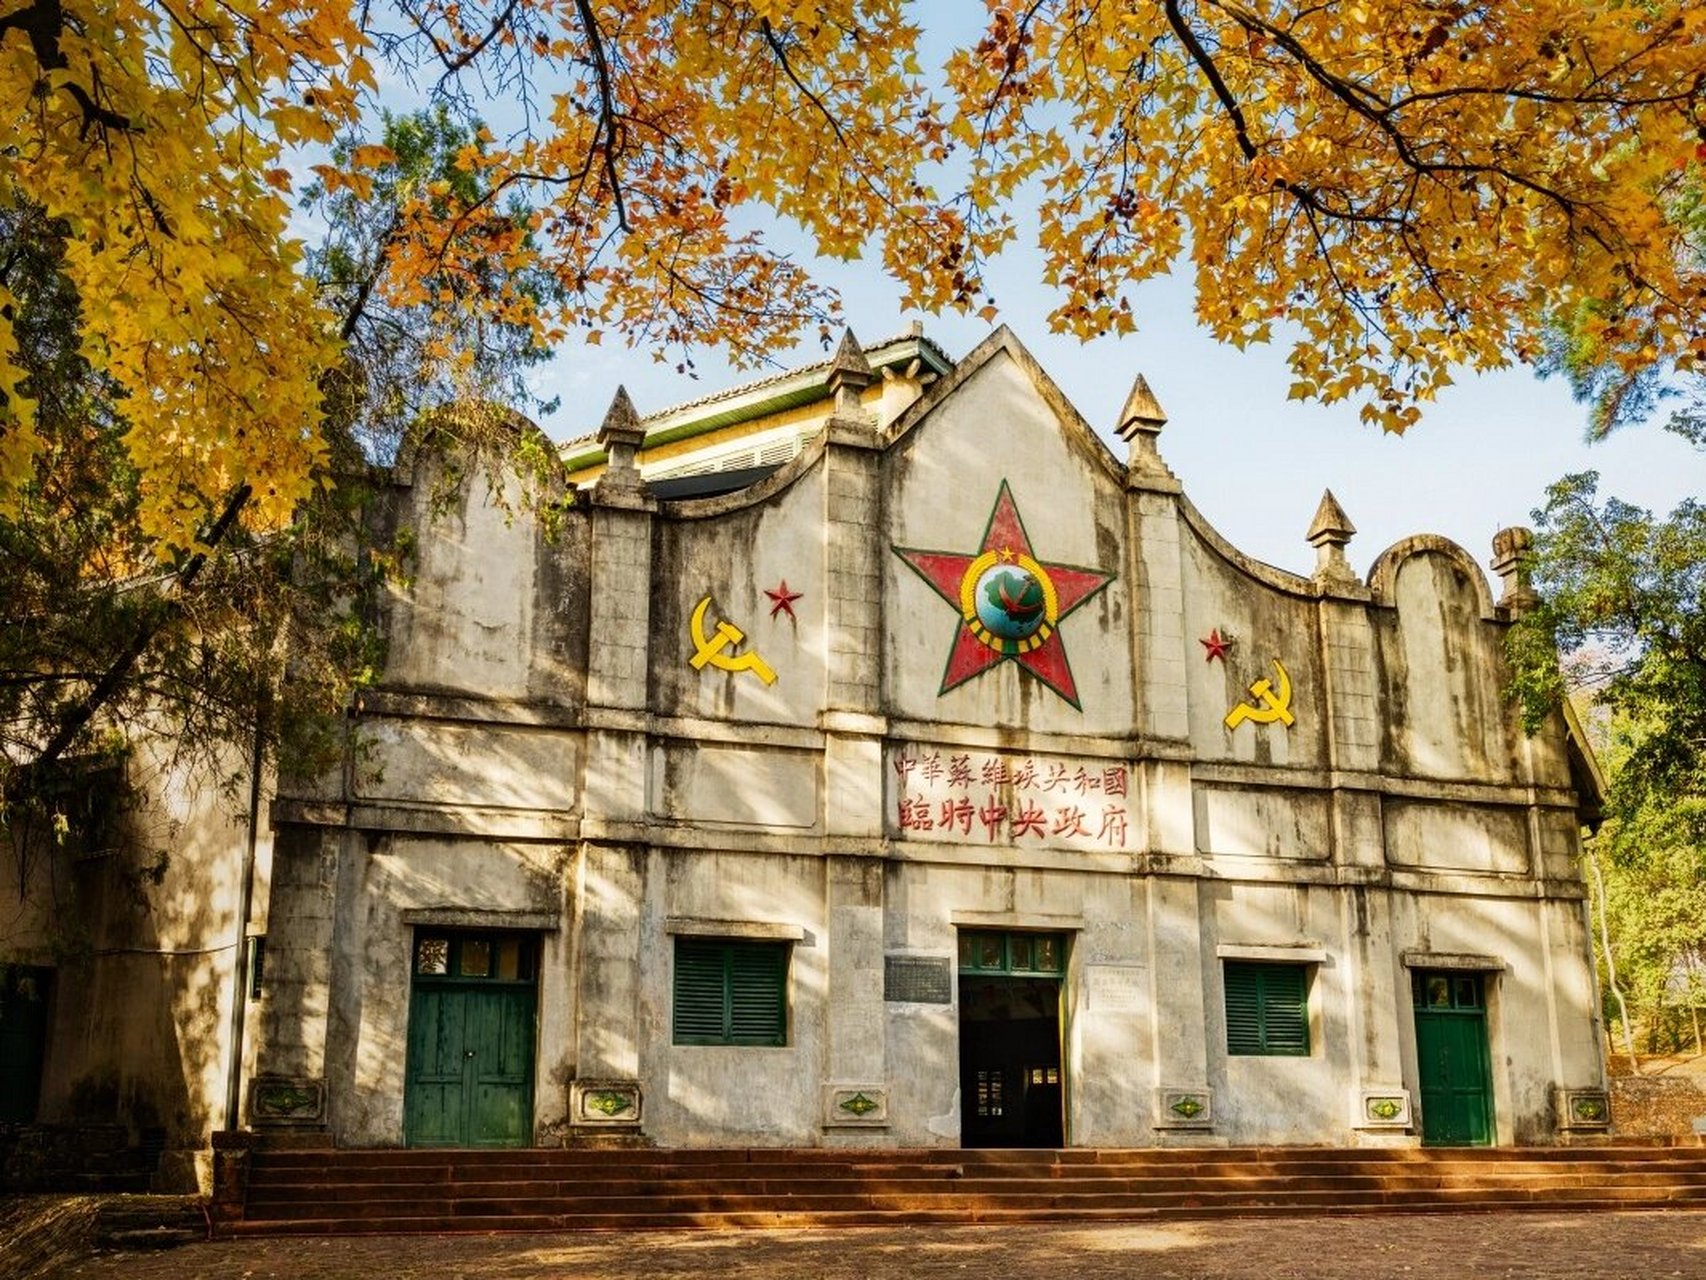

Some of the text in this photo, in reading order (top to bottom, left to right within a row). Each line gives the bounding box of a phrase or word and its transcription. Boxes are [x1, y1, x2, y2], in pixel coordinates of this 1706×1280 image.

[897, 793, 1128, 847] 臨時中央政府
